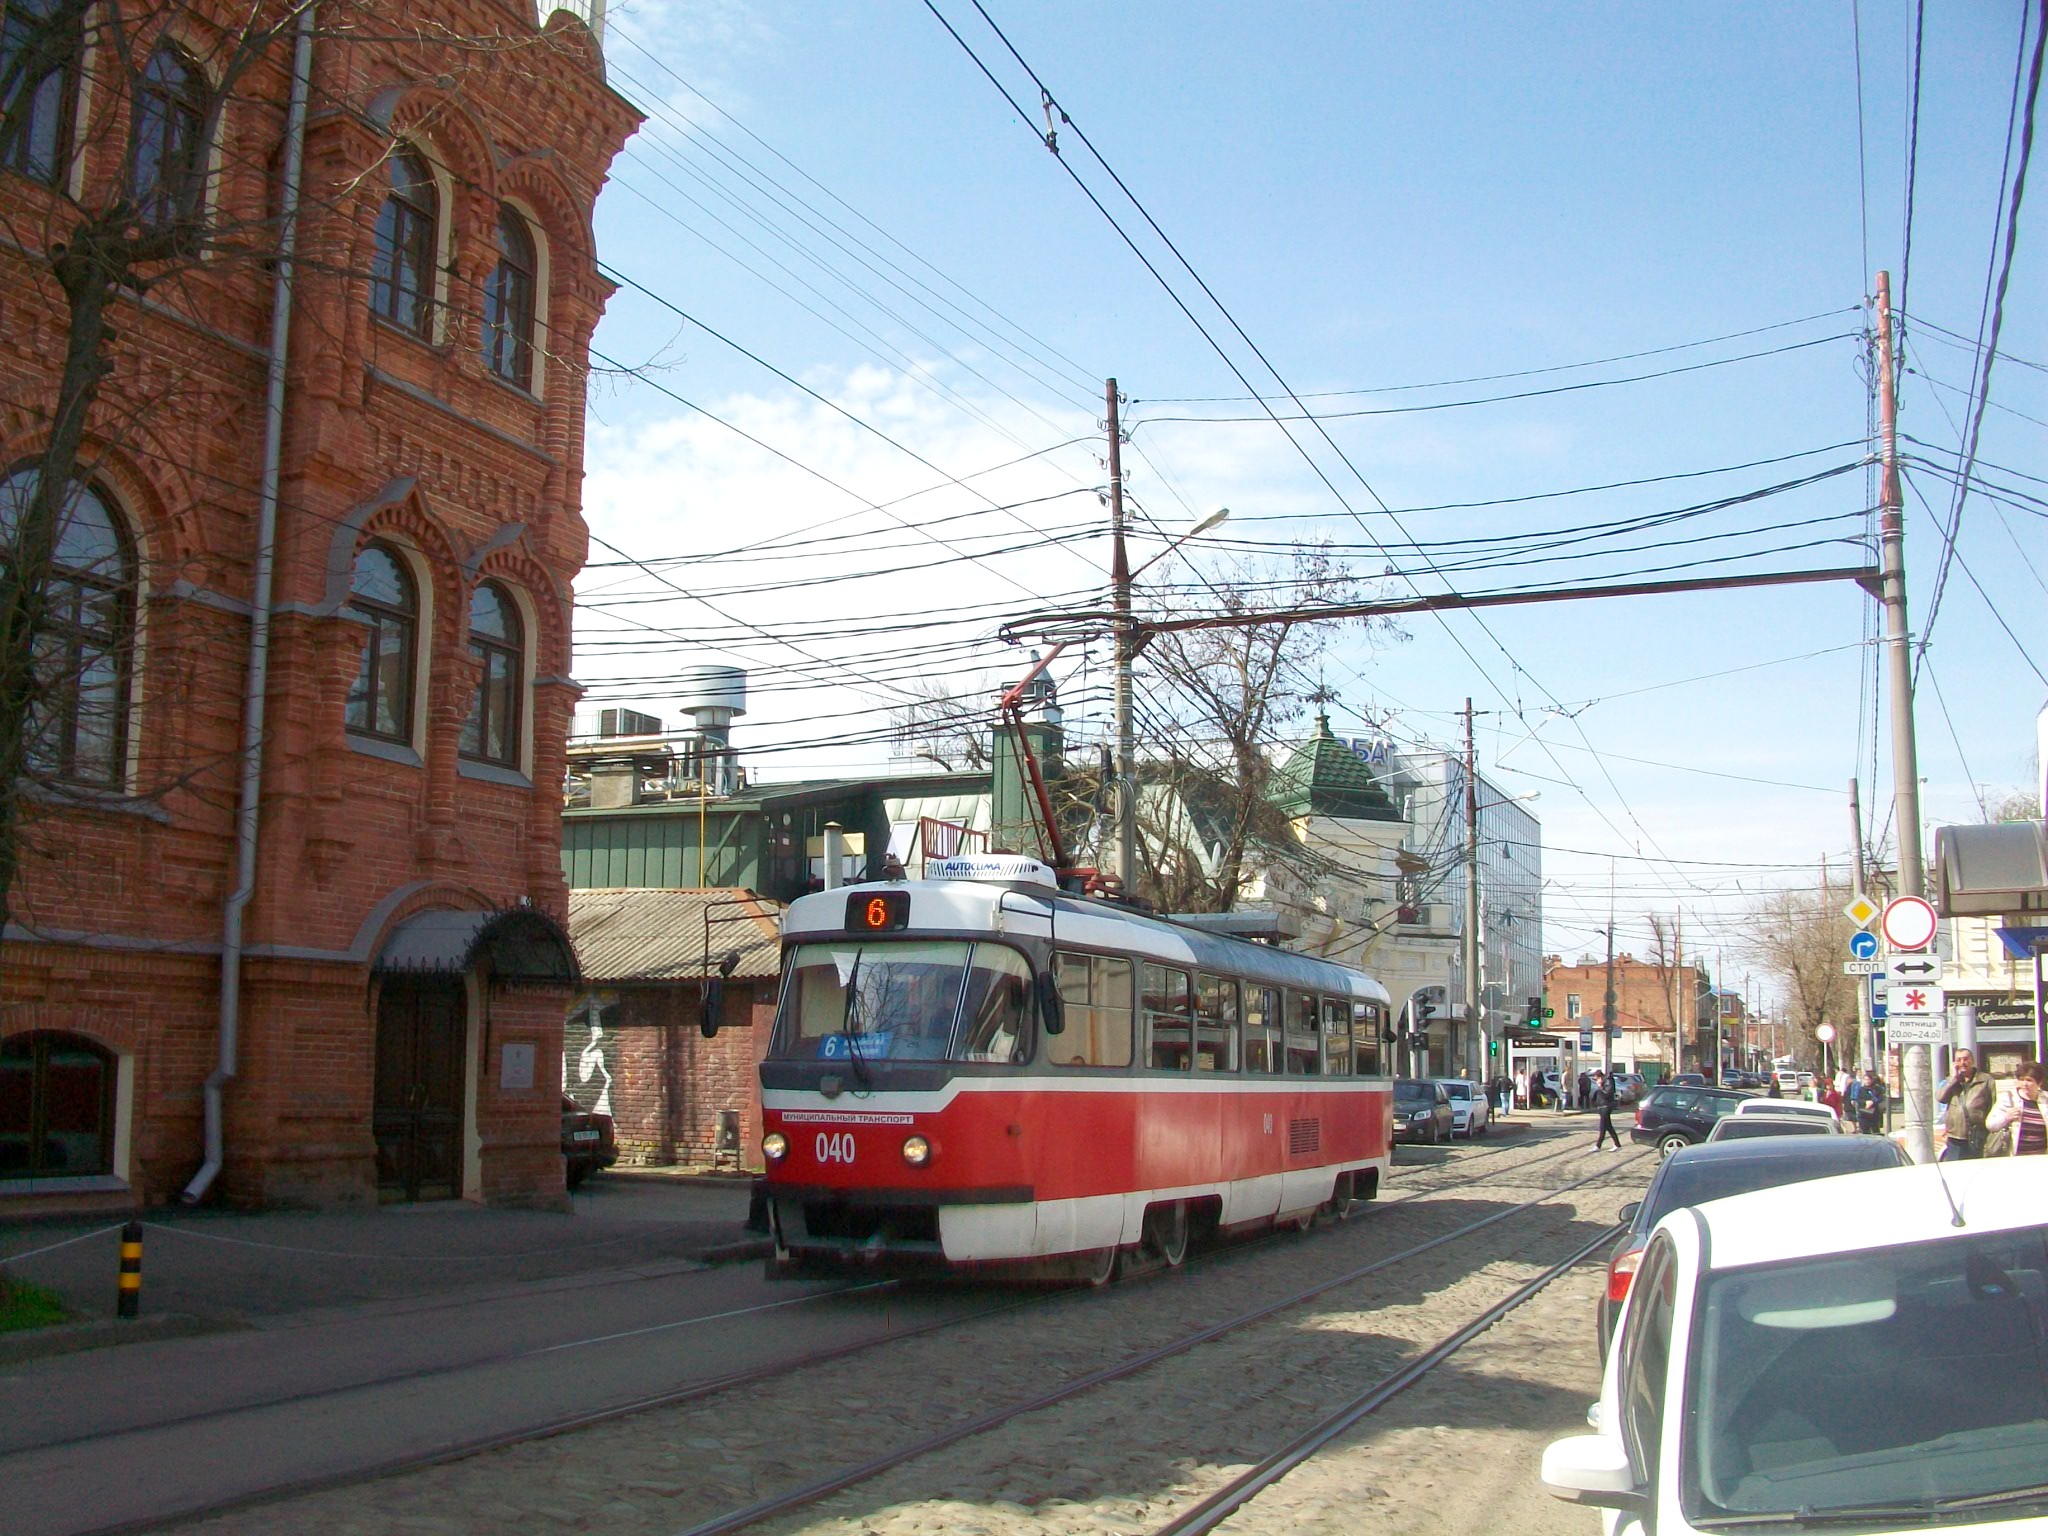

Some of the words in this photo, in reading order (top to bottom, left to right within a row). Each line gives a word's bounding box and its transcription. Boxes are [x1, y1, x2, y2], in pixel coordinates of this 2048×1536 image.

[945, 861, 1001, 871] AUTOCLIMA
[868, 898, 885, 926] 6
[1849, 963, 1879, 972] СТОП
[1899, 1021, 1938, 1029] пятница
[824, 1036, 838, 1057] 6
[783, 1113, 857, 1122] МУНИЦИПАЛЬНЫЙ
[858, 1115, 912, 1124] ТРАНСПОРТ
[815, 1132, 856, 1164] 040
